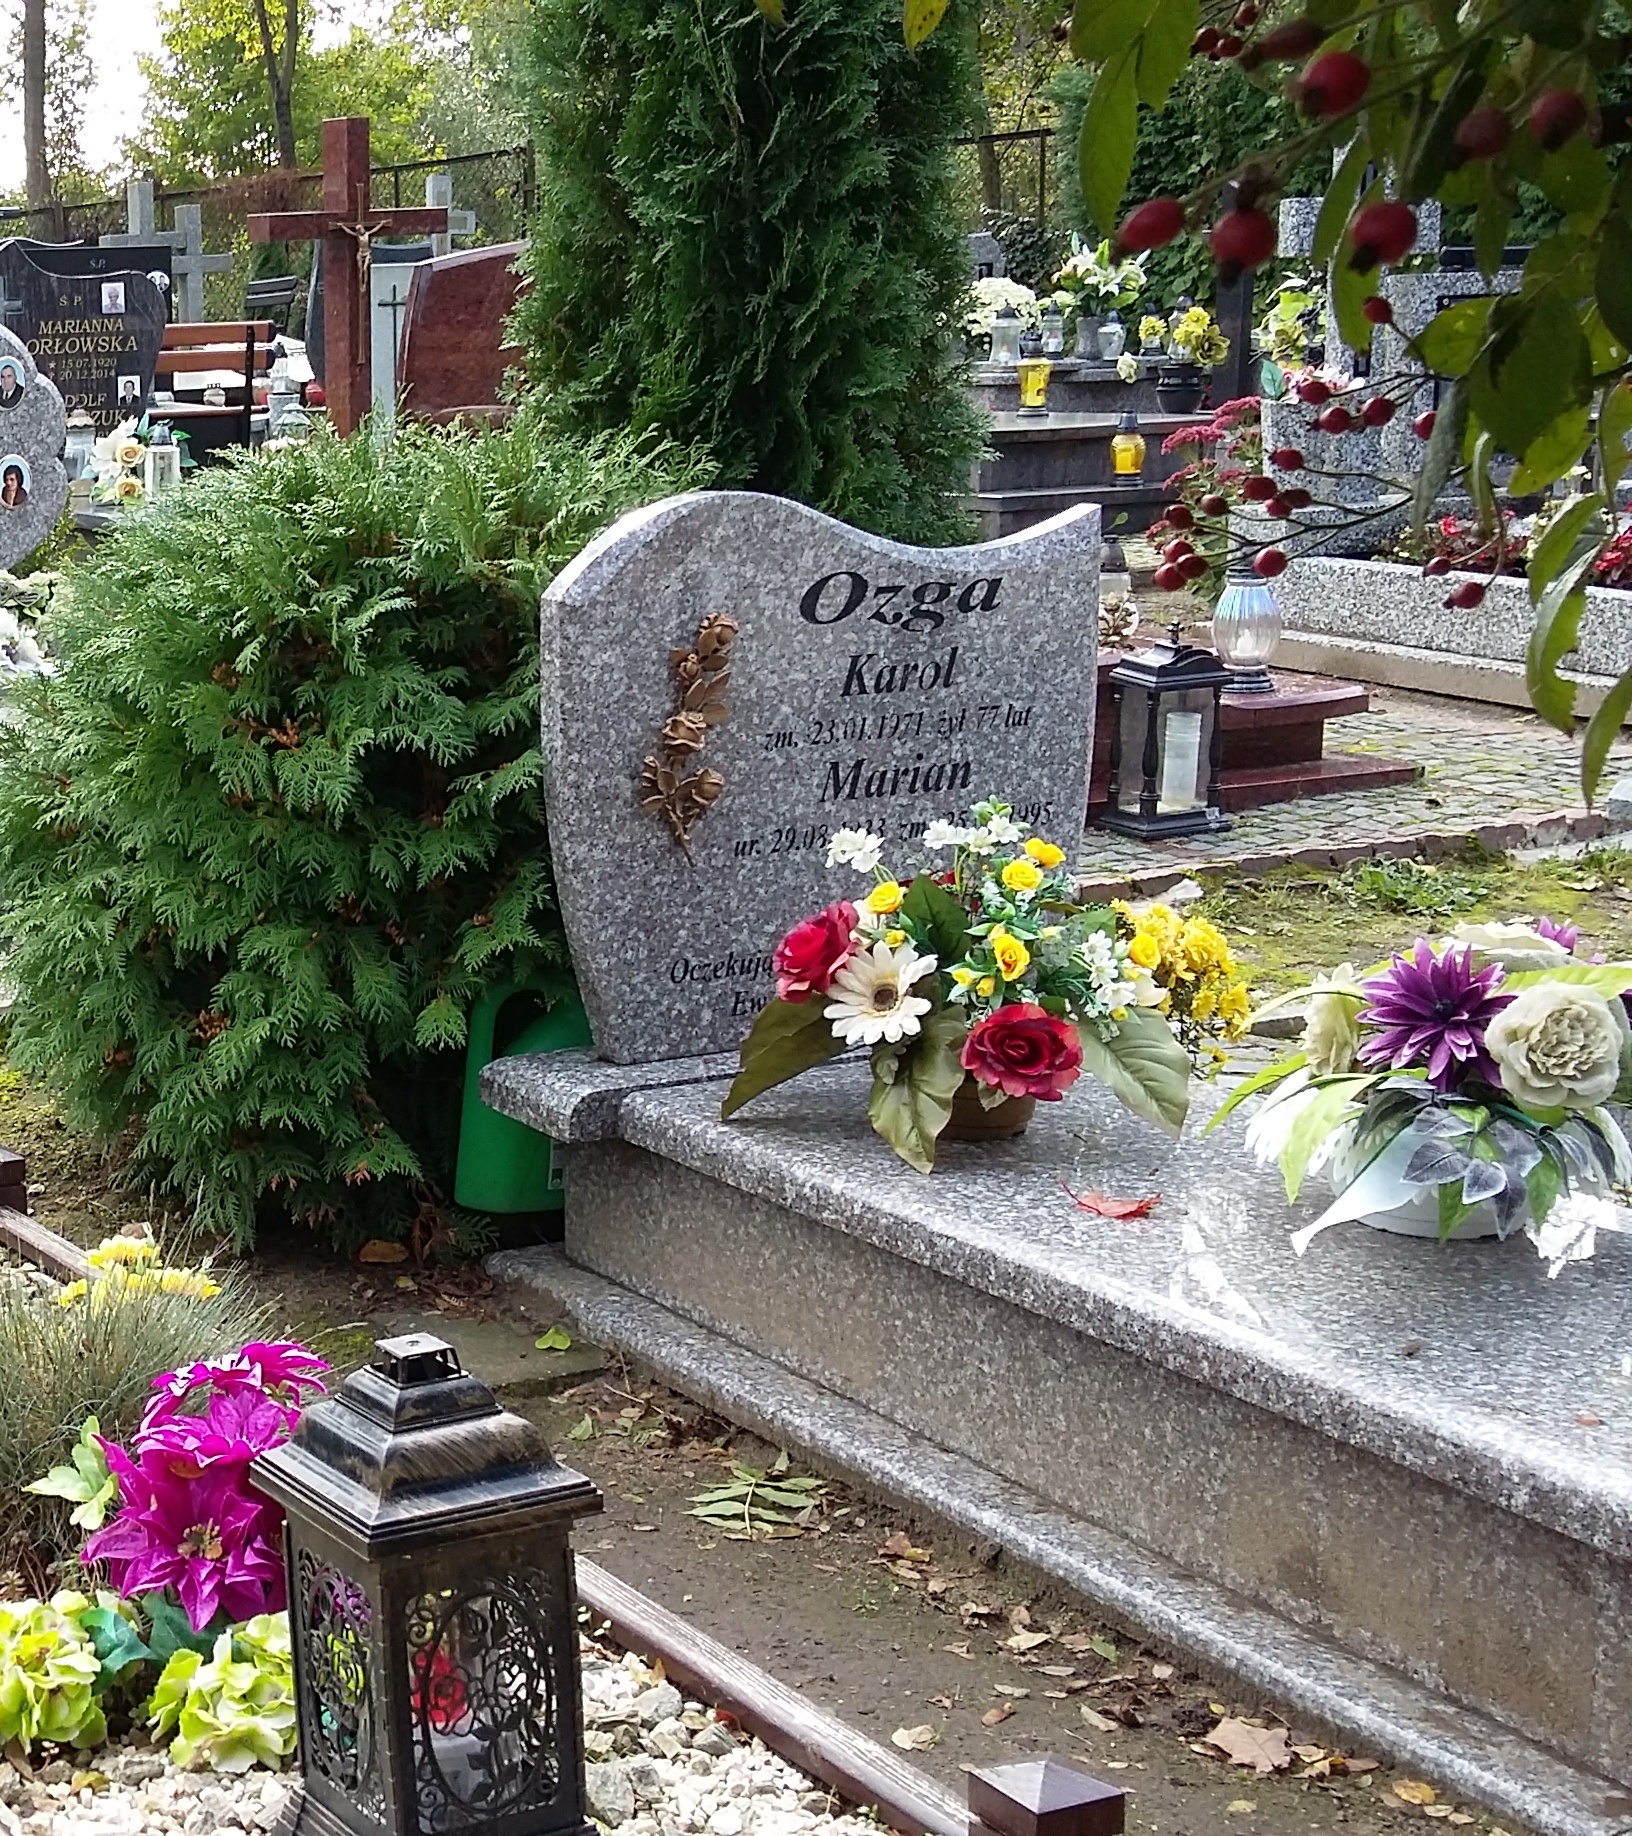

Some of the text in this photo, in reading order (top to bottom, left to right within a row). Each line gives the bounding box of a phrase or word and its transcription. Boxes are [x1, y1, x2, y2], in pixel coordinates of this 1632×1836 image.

[26, 336, 139, 356] ORŁOWSKA
[39, 318, 124, 335] MARIANNA
[799, 571, 1004, 633] Ozga
[839, 646, 960, 698] Karol
[810, 711, 925, 746] 23.01.1971
[977, 704, 1001, 730] 77
[1004, 703, 1033, 729] lat
[818, 752, 972, 803] Marian
